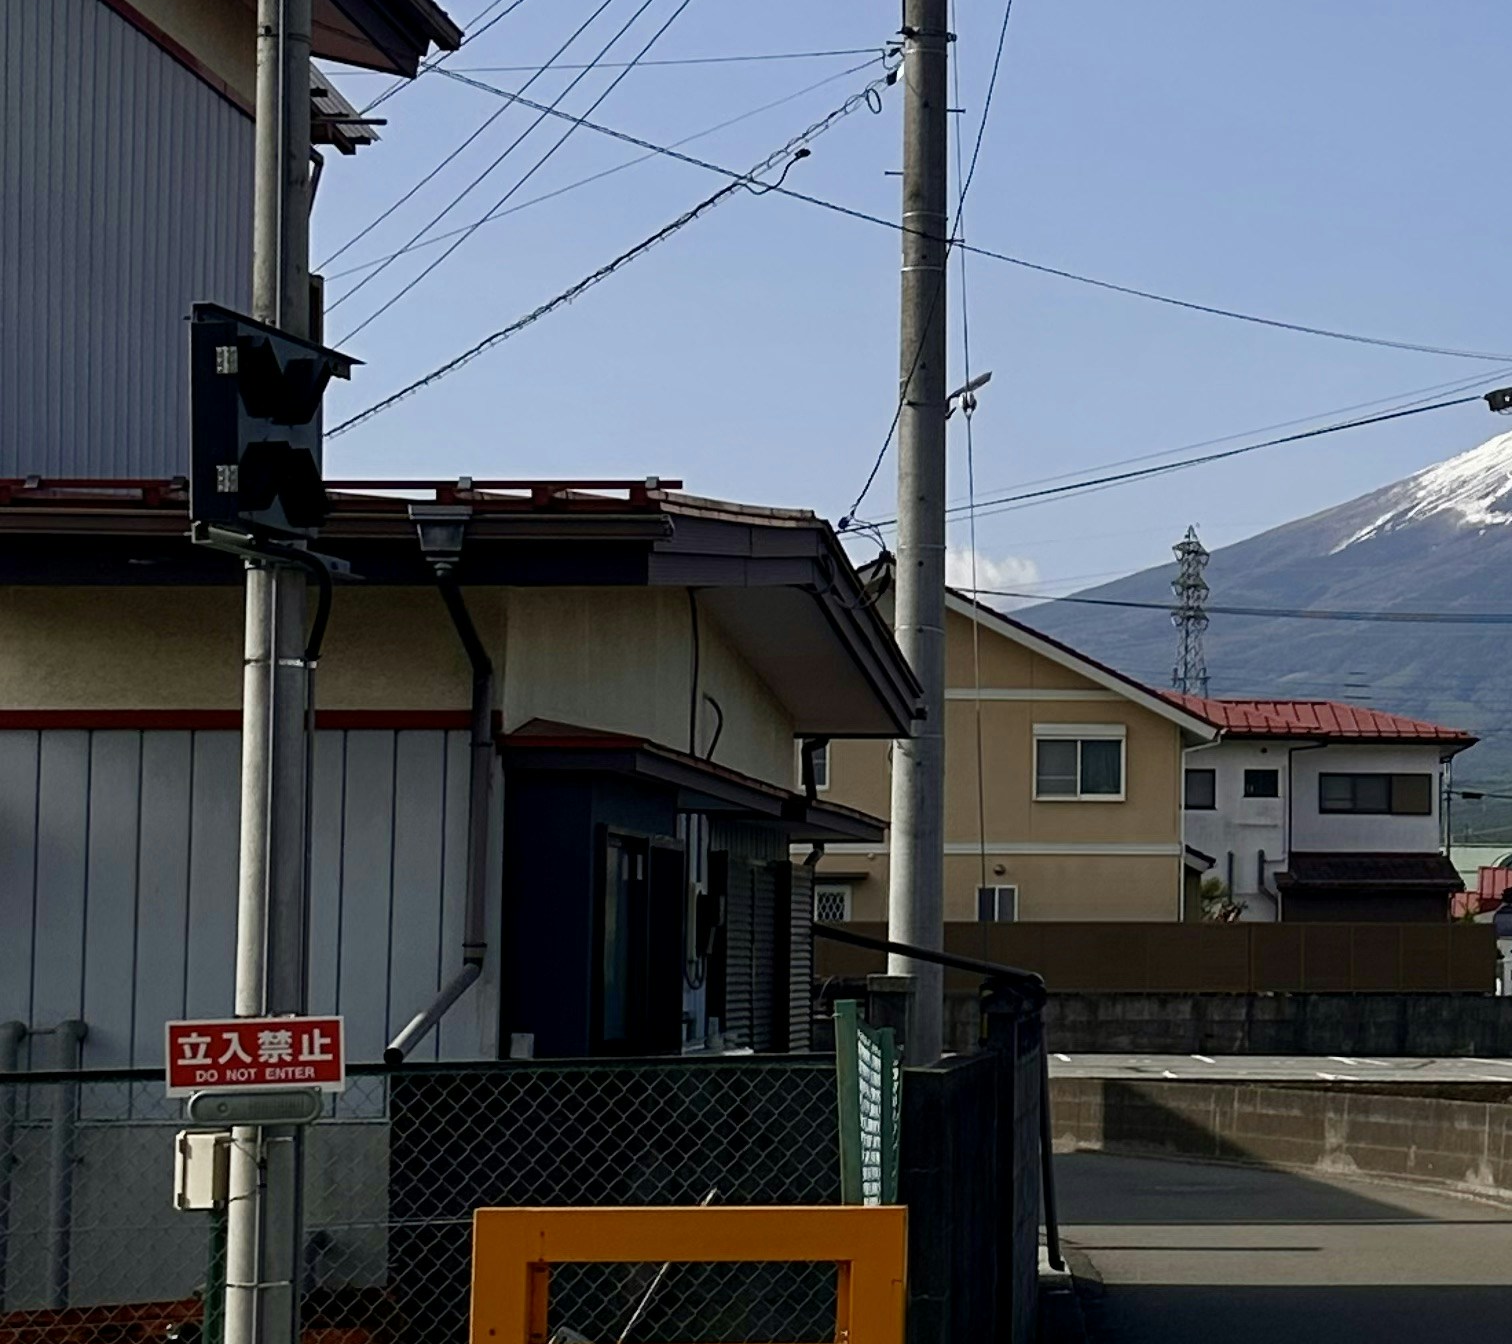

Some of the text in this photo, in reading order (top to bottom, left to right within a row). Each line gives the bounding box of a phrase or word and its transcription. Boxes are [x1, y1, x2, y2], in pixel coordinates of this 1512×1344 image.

[177, 1028, 333, 1065] 立入禁止
[195, 1066, 315, 1083] DO NOT ENTER
